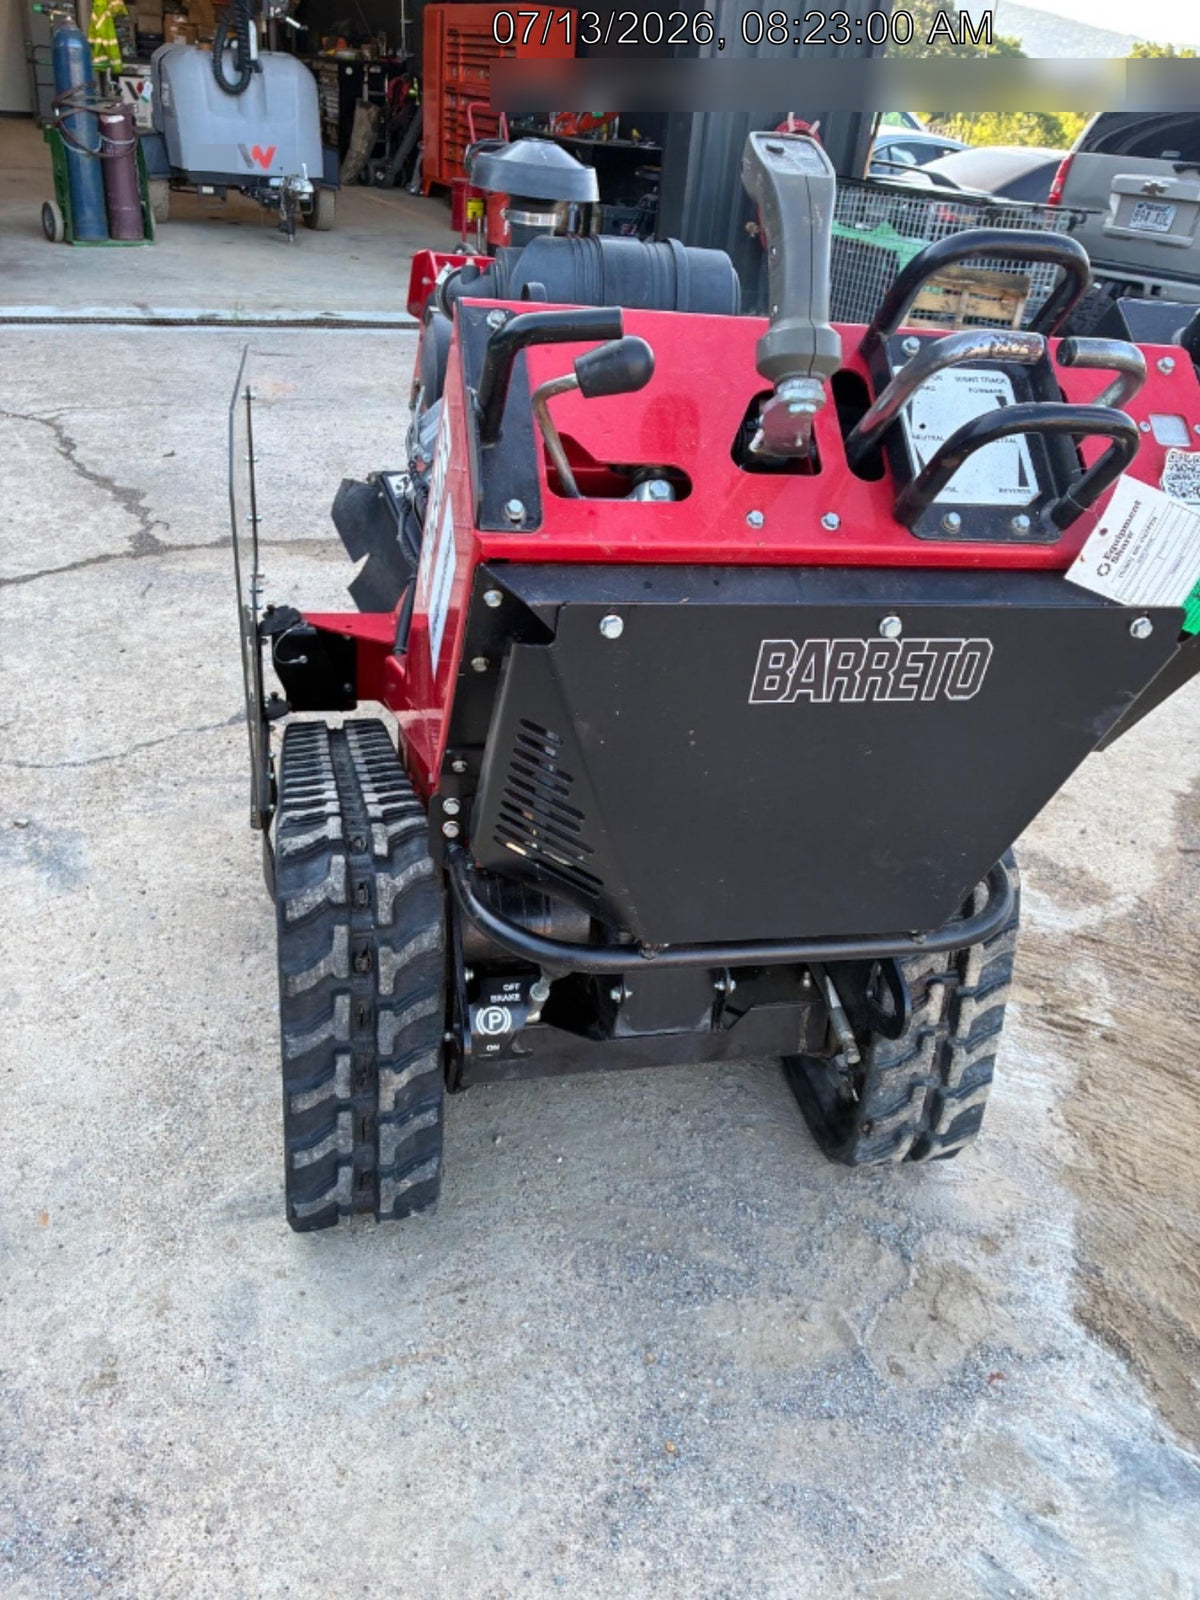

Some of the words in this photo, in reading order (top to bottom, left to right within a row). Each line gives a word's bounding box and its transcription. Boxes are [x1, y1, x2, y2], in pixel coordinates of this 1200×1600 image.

[1103, 500, 1142, 562] Equipment
[748, 637, 994, 705] BARRETO
[502, 982, 521, 991] OFF
[490, 993, 521, 1003] BRAKE
[486, 1044, 500, 1052] ON
